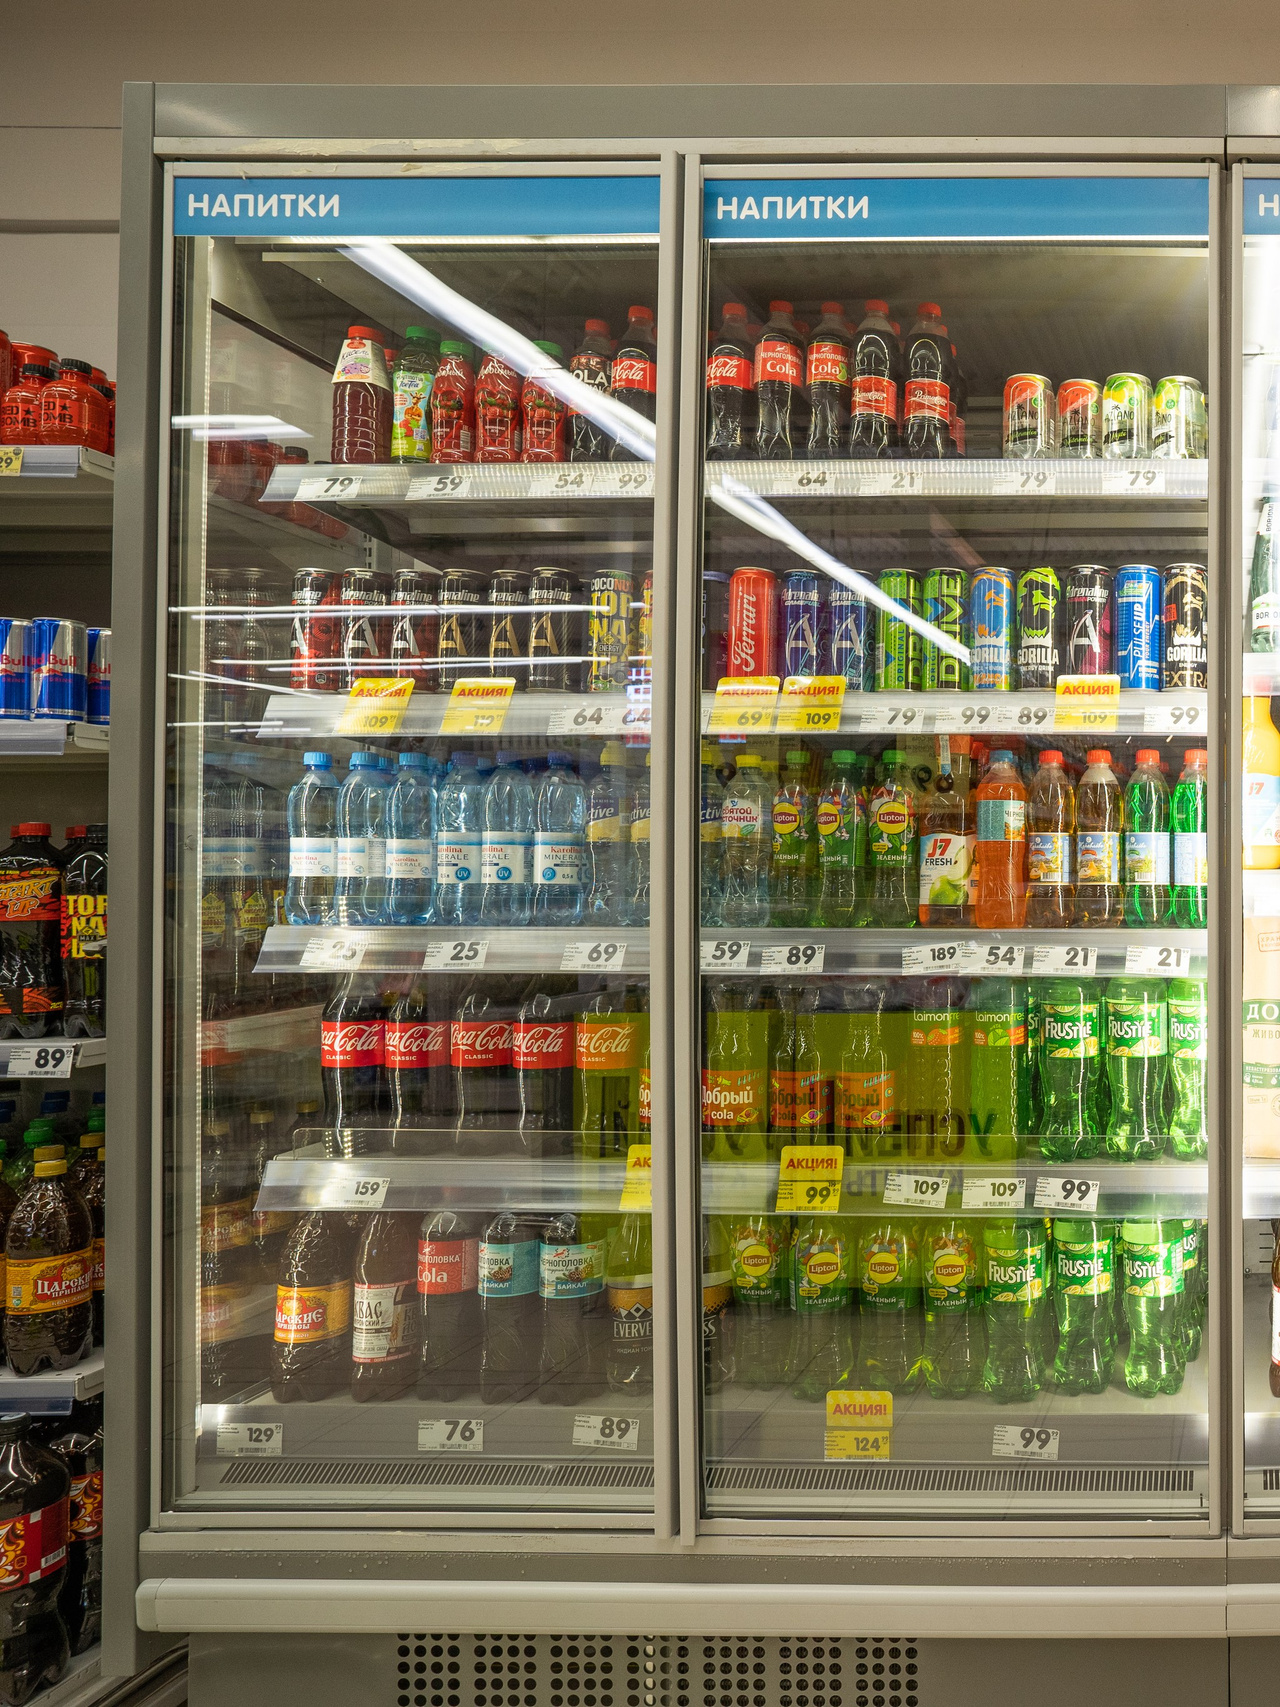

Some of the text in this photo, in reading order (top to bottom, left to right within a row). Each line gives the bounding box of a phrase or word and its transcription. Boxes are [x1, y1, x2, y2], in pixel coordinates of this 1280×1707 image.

[188, 193, 340, 218] НАПИТКИ
[717, 195, 869, 220] НАПИТКИ
[766, 361, 797, 377] Cola
[811, 362, 840, 375] Cola
[324, 477, 354, 493] 79
[434, 476, 463, 493] 59
[555, 473, 584, 489] 54
[619, 473, 647, 490] 99
[798, 472, 828, 488] 64
[1020, 472, 1048, 488] 79
[1128, 471, 1157, 486] 79
[48, 654, 77, 667] Bull
[897, 628, 905, 683] ORIGINAL
[969, 647, 1010, 664] GORILLA
[1017, 647, 1060, 665] GORILLA
[457, 687, 509, 699] АКЦИЯ!
[788, 686, 840, 697] АКЦИЯ!
[1062, 684, 1115, 696] АКЦИЯ!
[363, 715, 389, 727] 109
[573, 707, 603, 726] 64
[737, 711, 762, 726] 69
[806, 712, 831, 725] 109
[887, 708, 916, 726] 79
[961, 707, 991, 725] 99
[1018, 707, 1047, 726] 89
[1081, 711, 1108, 724] 109
[1170, 707, 1200, 725] 99
[774, 814, 796, 823] Lipton
[879, 814, 906, 823] Lipton
[927, 838, 952, 857] J7
[925, 858, 952, 866] FRESH
[6, 898, 39, 918] UP
[451, 942, 480, 961] 25
[587, 943, 618, 962] 69
[712, 941, 742, 961] 59
[786, 946, 817, 965] 89
[930, 946, 956, 962] 189
[985, 946, 1015, 965] 54
[1064, 947, 1089, 966] 21
[1157, 947, 1182, 967] 21
[35, 1049, 65, 1069] 89
[711, 1109, 734, 1120] cola
[786, 1157, 838, 1171] АКЦИЯ!
[354, 1181, 380, 1196] 159
[805, 1187, 831, 1205] 99
[913, 1180, 940, 1196] 109
[990, 1182, 1018, 1197] 109
[1061, 1180, 1090, 1201] 99
[744, 1256, 768, 1266] Lipton
[811, 1263, 837, 1274] Lipton
[871, 1263, 895, 1273] Lipton
[1058, 1254, 1104, 1277] FRUSTYLE
[418, 1267, 448, 1283] Cola
[937, 1265, 962, 1275] Lipton
[988, 1260, 1036, 1283] FRUSTYLE
[557, 1281, 588, 1290] БАЙКАЛ
[804, 1295, 840, 1305] ЗЕЛЕНЫЙ
[833, 1404, 887, 1416] АКЦИЯ!
[247, 1427, 274, 1443] 129
[445, 1420, 475, 1442] 76
[600, 1417, 630, 1440] 89
[854, 1437, 881, 1452] 124
[1020, 1427, 1051, 1450] 99
